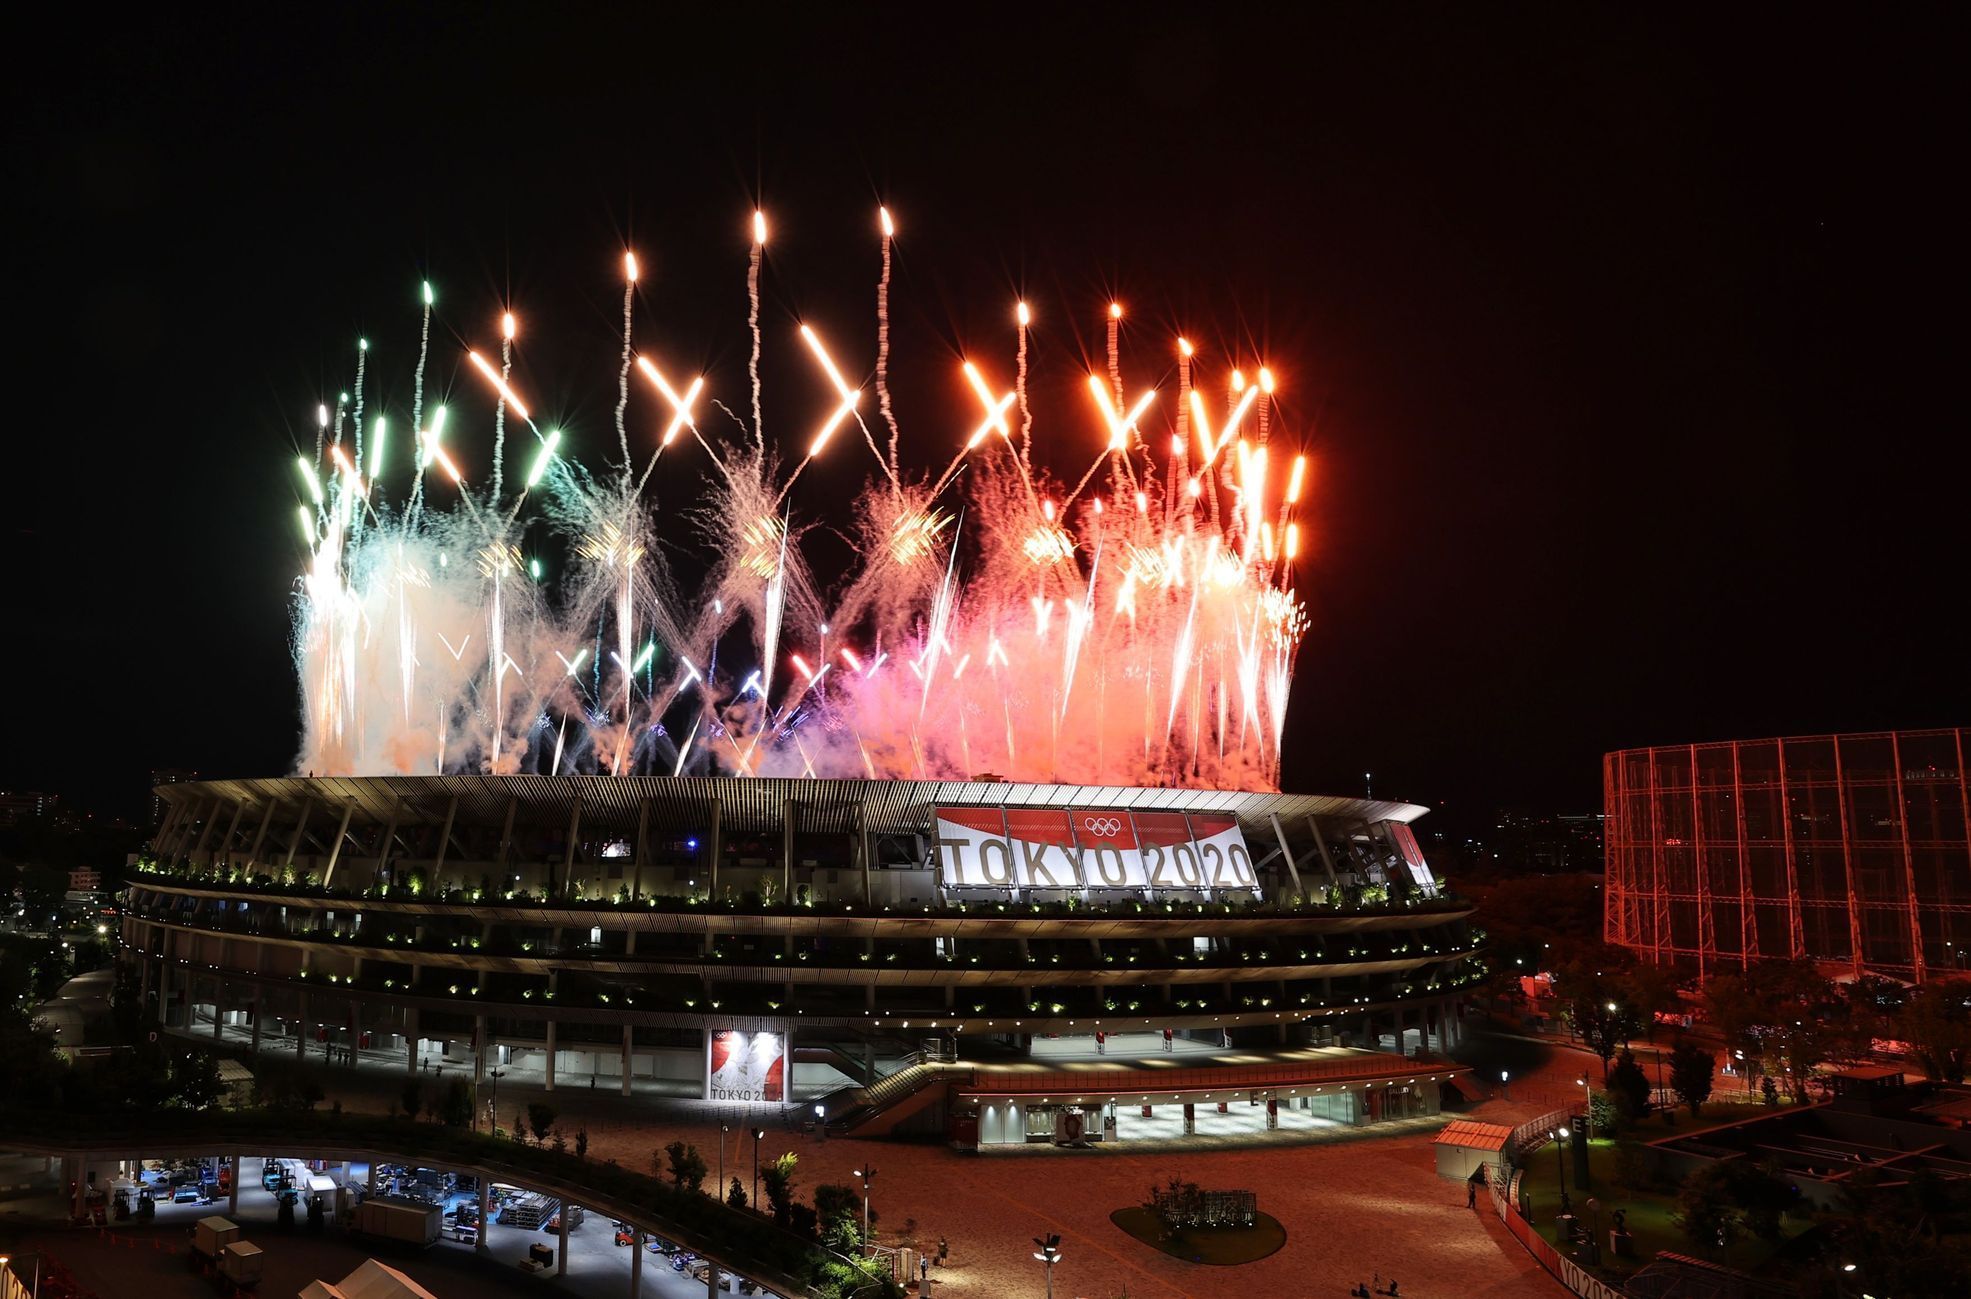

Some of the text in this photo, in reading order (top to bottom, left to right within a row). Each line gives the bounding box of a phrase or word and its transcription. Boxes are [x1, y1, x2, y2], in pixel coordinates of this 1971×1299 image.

[941, 838, 1255, 887] TOKYO 2020
[711, 1088, 751, 1101] TOKYO
[1572, 1118, 1582, 1133] E
[1584, 1274, 1623, 1299] 20
